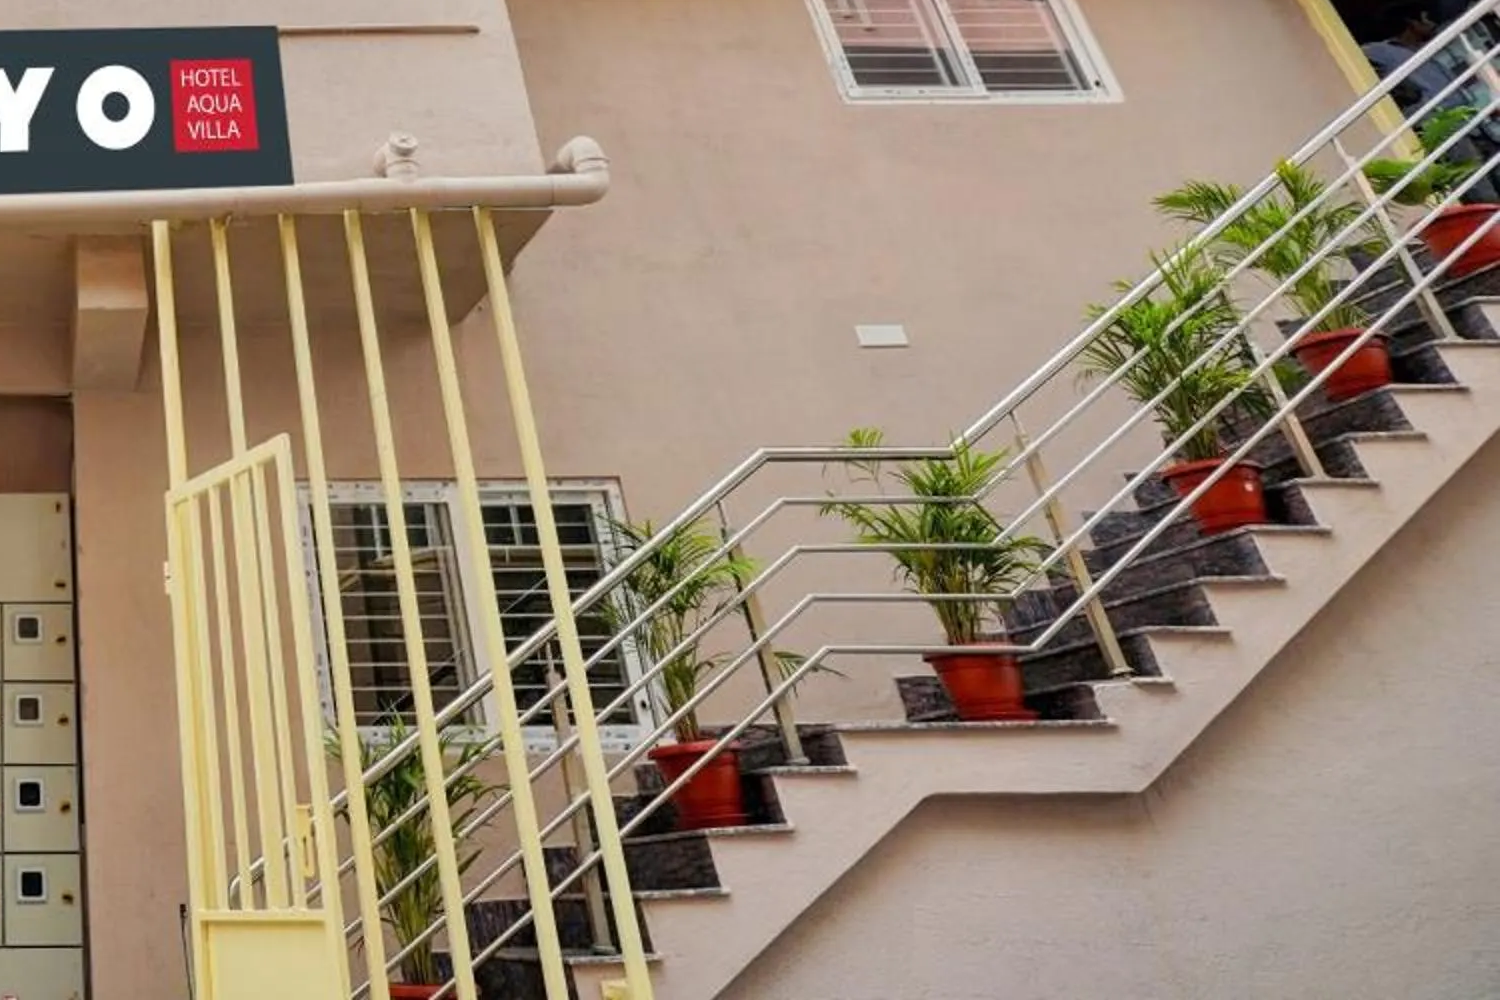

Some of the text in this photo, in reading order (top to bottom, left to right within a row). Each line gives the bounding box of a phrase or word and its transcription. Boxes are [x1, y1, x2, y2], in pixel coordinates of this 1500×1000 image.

[180, 68, 241, 88] HOTEL
[187, 94, 243, 115] AQUA
[187, 120, 241, 140] VILLA
